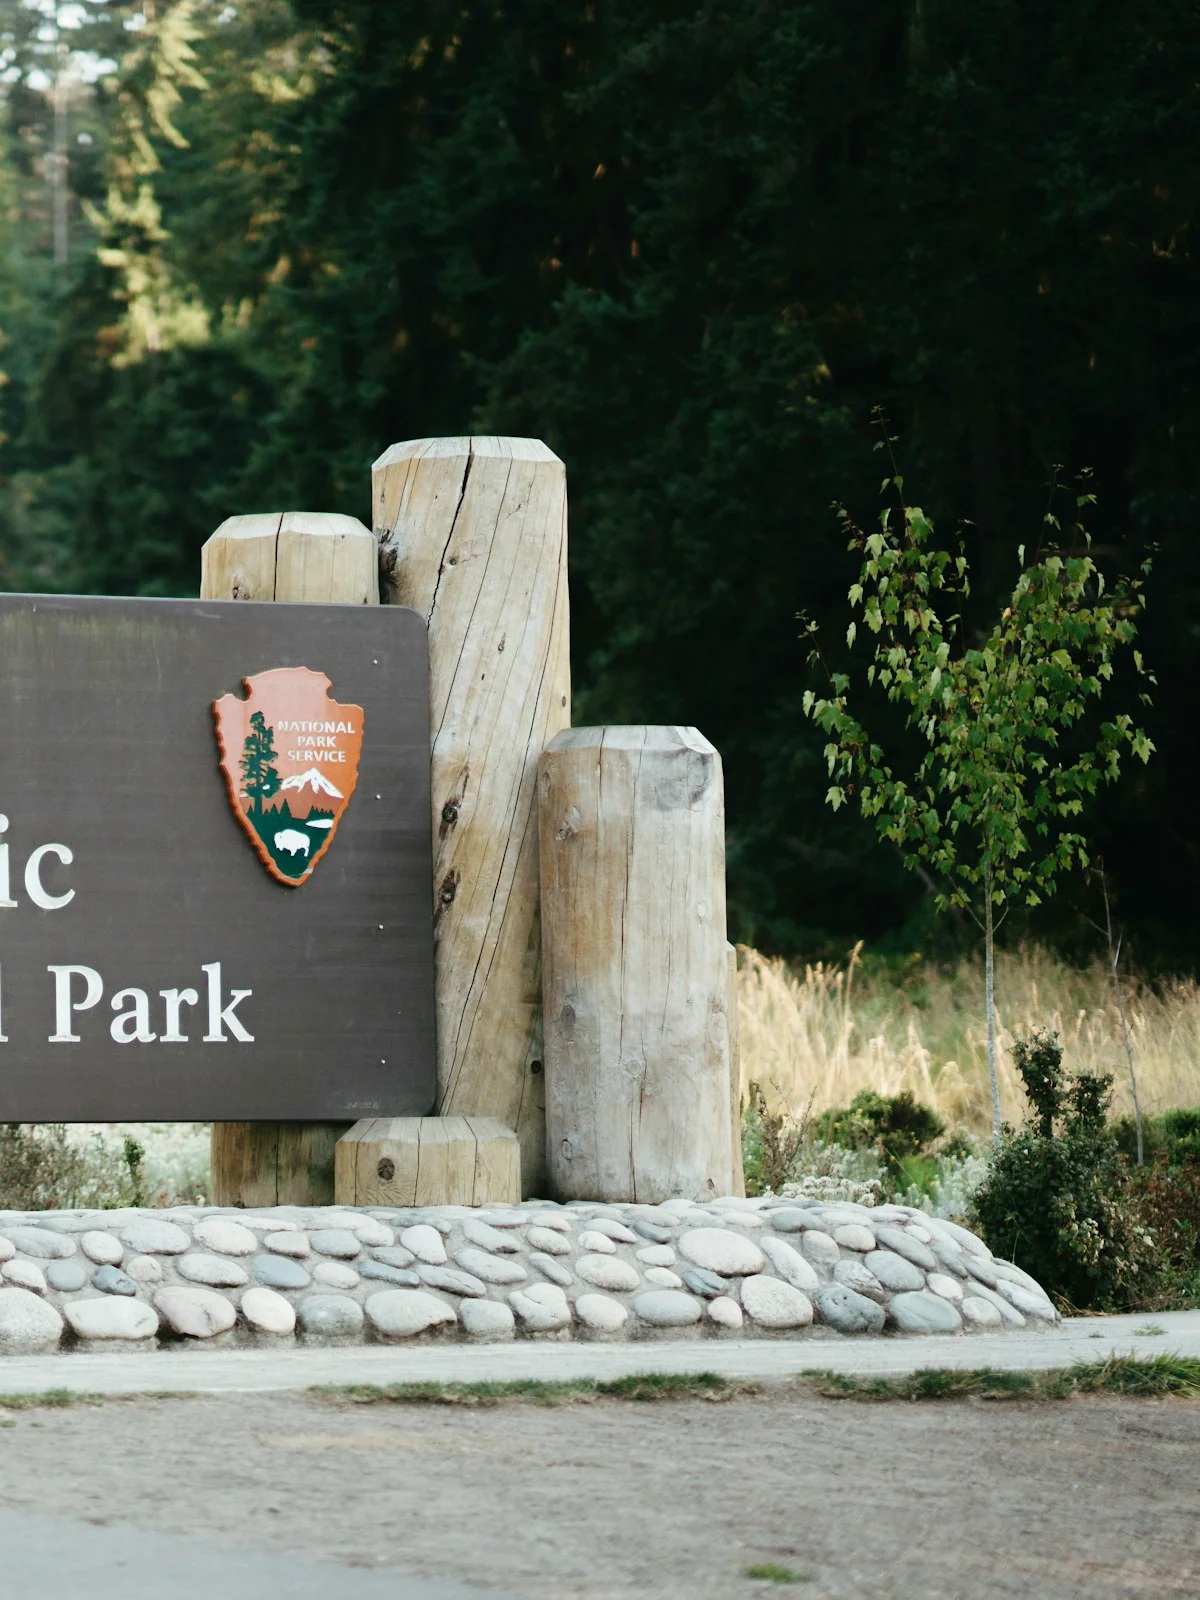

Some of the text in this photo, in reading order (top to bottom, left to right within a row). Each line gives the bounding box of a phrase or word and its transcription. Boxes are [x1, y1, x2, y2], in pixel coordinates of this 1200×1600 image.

[278, 720, 356, 734] NATIONAL
[297, 735, 337, 748] PARK
[287, 749, 346, 763] SERVICE
[46, 962, 255, 1045] Park
